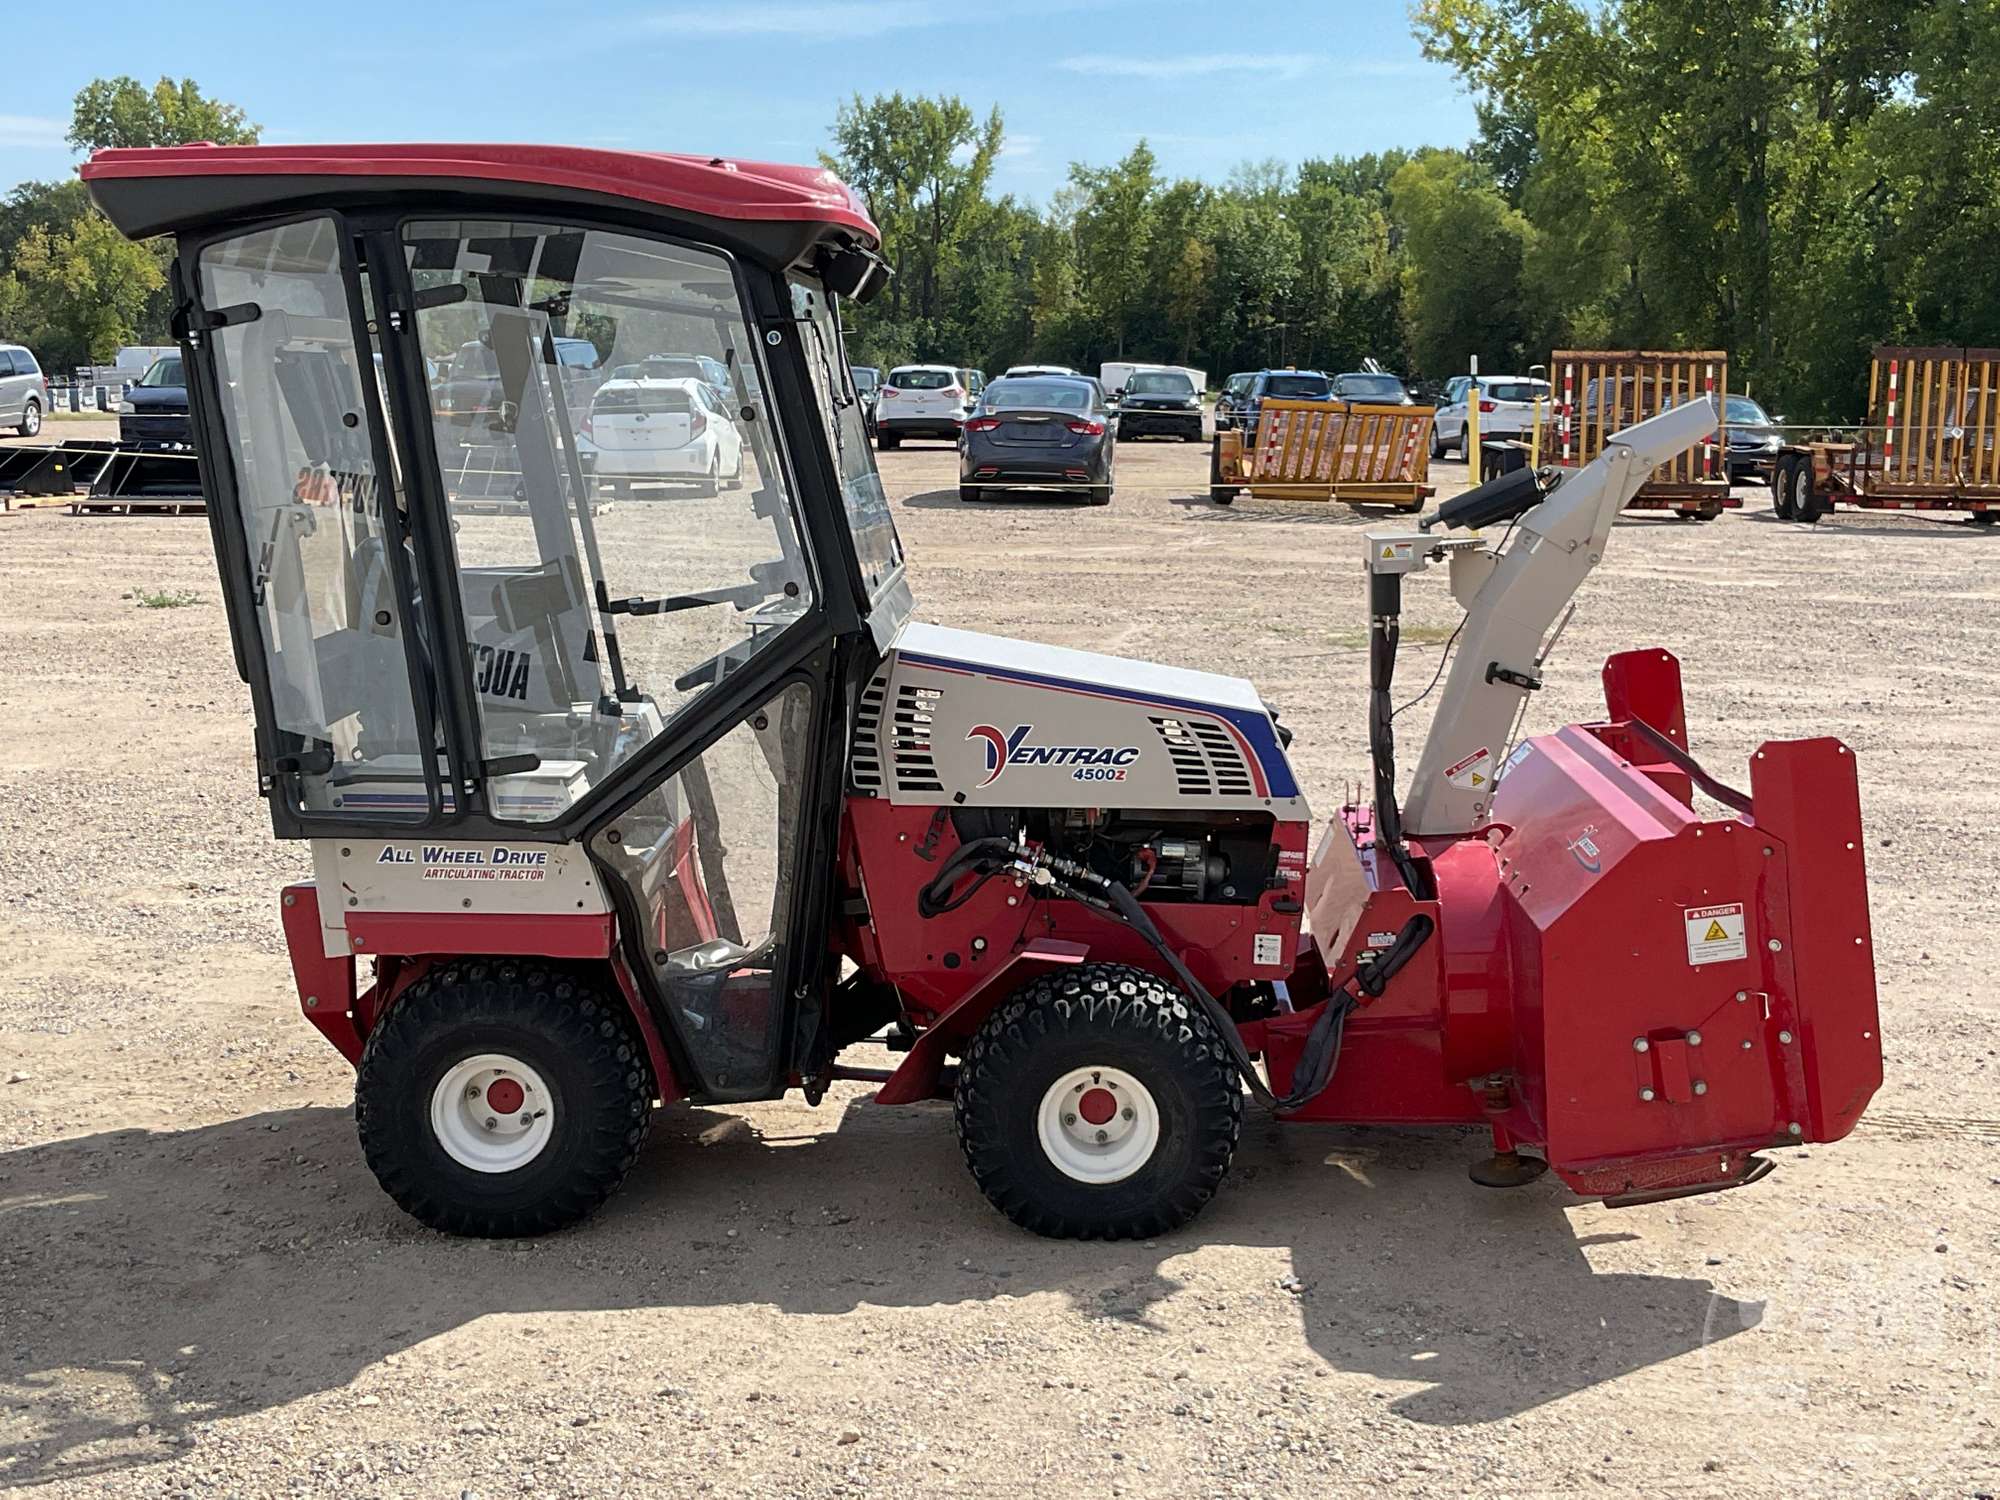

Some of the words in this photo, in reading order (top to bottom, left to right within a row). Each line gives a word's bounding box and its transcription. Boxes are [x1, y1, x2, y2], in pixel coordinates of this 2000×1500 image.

[983, 724, 1140, 771] VENTRAC
[1072, 768, 1126, 781] 4500Z
[424, 867, 495, 880] ARTICULATING
[498, 868, 545, 881] TRACTOR
[1700, 906, 1736, 918] DANGER
